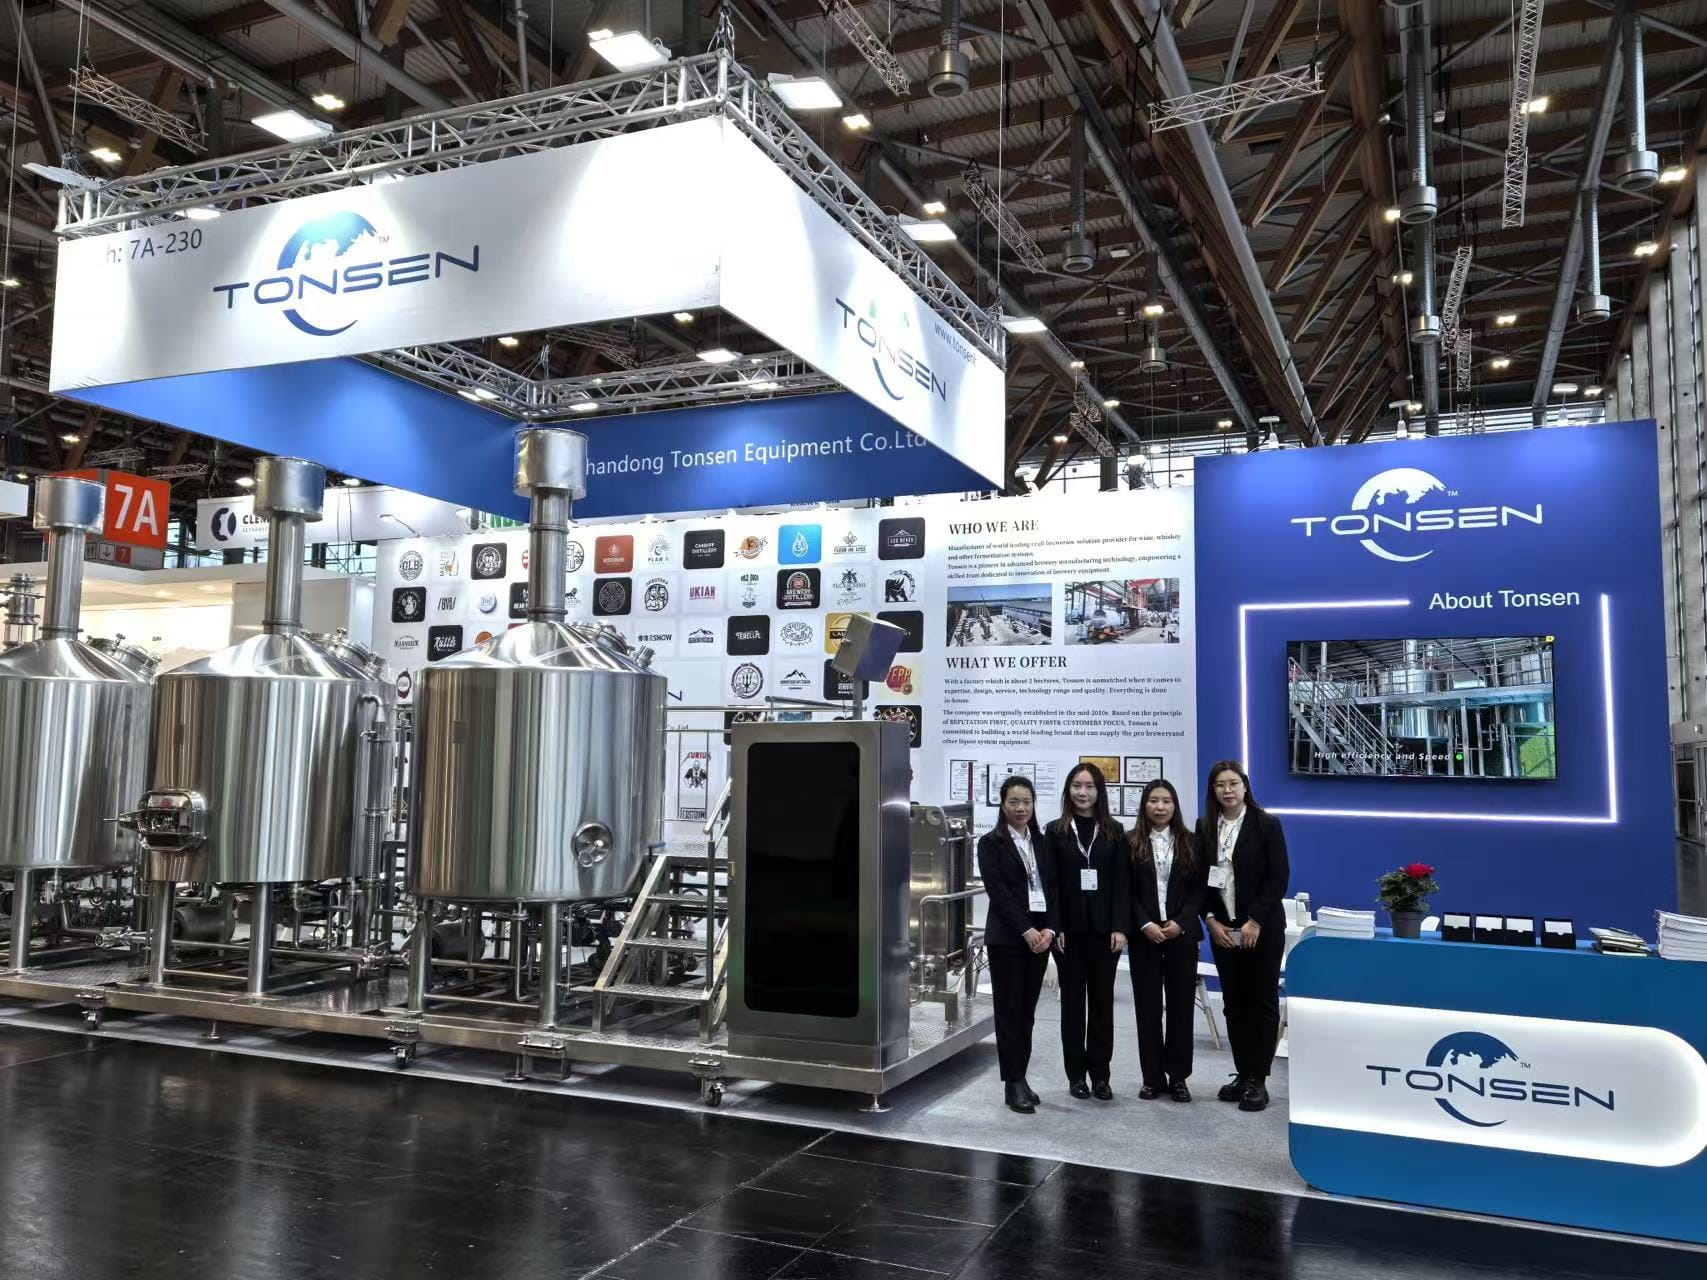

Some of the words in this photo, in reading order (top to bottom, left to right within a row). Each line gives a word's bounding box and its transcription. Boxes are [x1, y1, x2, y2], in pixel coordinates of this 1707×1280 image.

[130, 228, 202, 260] 7A-230
[213, 244, 480, 309] TONSEN
[835, 297, 946, 402] TONSEN
[585, 453, 664, 476] handong
[671, 447, 737, 469] Tonsen
[744, 435, 853, 466] Equipment
[114, 483, 158, 536] 7A
[949, 522, 982, 535] WHO
[986, 521, 1008, 533] WE
[1013, 519, 1039, 531] ARE
[1290, 503, 1543, 537] TONSEN
[1102, 536, 1127, 544] provider
[978, 562, 999, 570] pioneer
[1059, 557, 1102, 565] manufacturing
[1138, 554, 1176, 562] empowering
[1015, 569, 1045, 577] innovation
[1053, 567, 1076, 575] brewery
[690, 586, 715, 598] UKIAH
[1429, 592, 1492, 610] About
[1498, 590, 1580, 607] Tonsen
[946, 657, 990, 669] WHAT
[994, 656, 1016, 669] WE
[1020, 656, 1067, 668] OFFER
[1018, 687, 1051, 695] technology
[1109, 686, 1143, 694] Everything
[1103, 719, 1127, 727] FOCUS,
[958, 738, 977, 746] liquor
[1314, 752, 1337, 760] High
[1341, 751, 1392, 760] efficiency
[1396, 752, 1415, 760] and
[1418, 752, 1451, 761] Speed
[1520, 1061, 1531, 1069] TM
[1365, 1064, 1615, 1111] TONSEN
